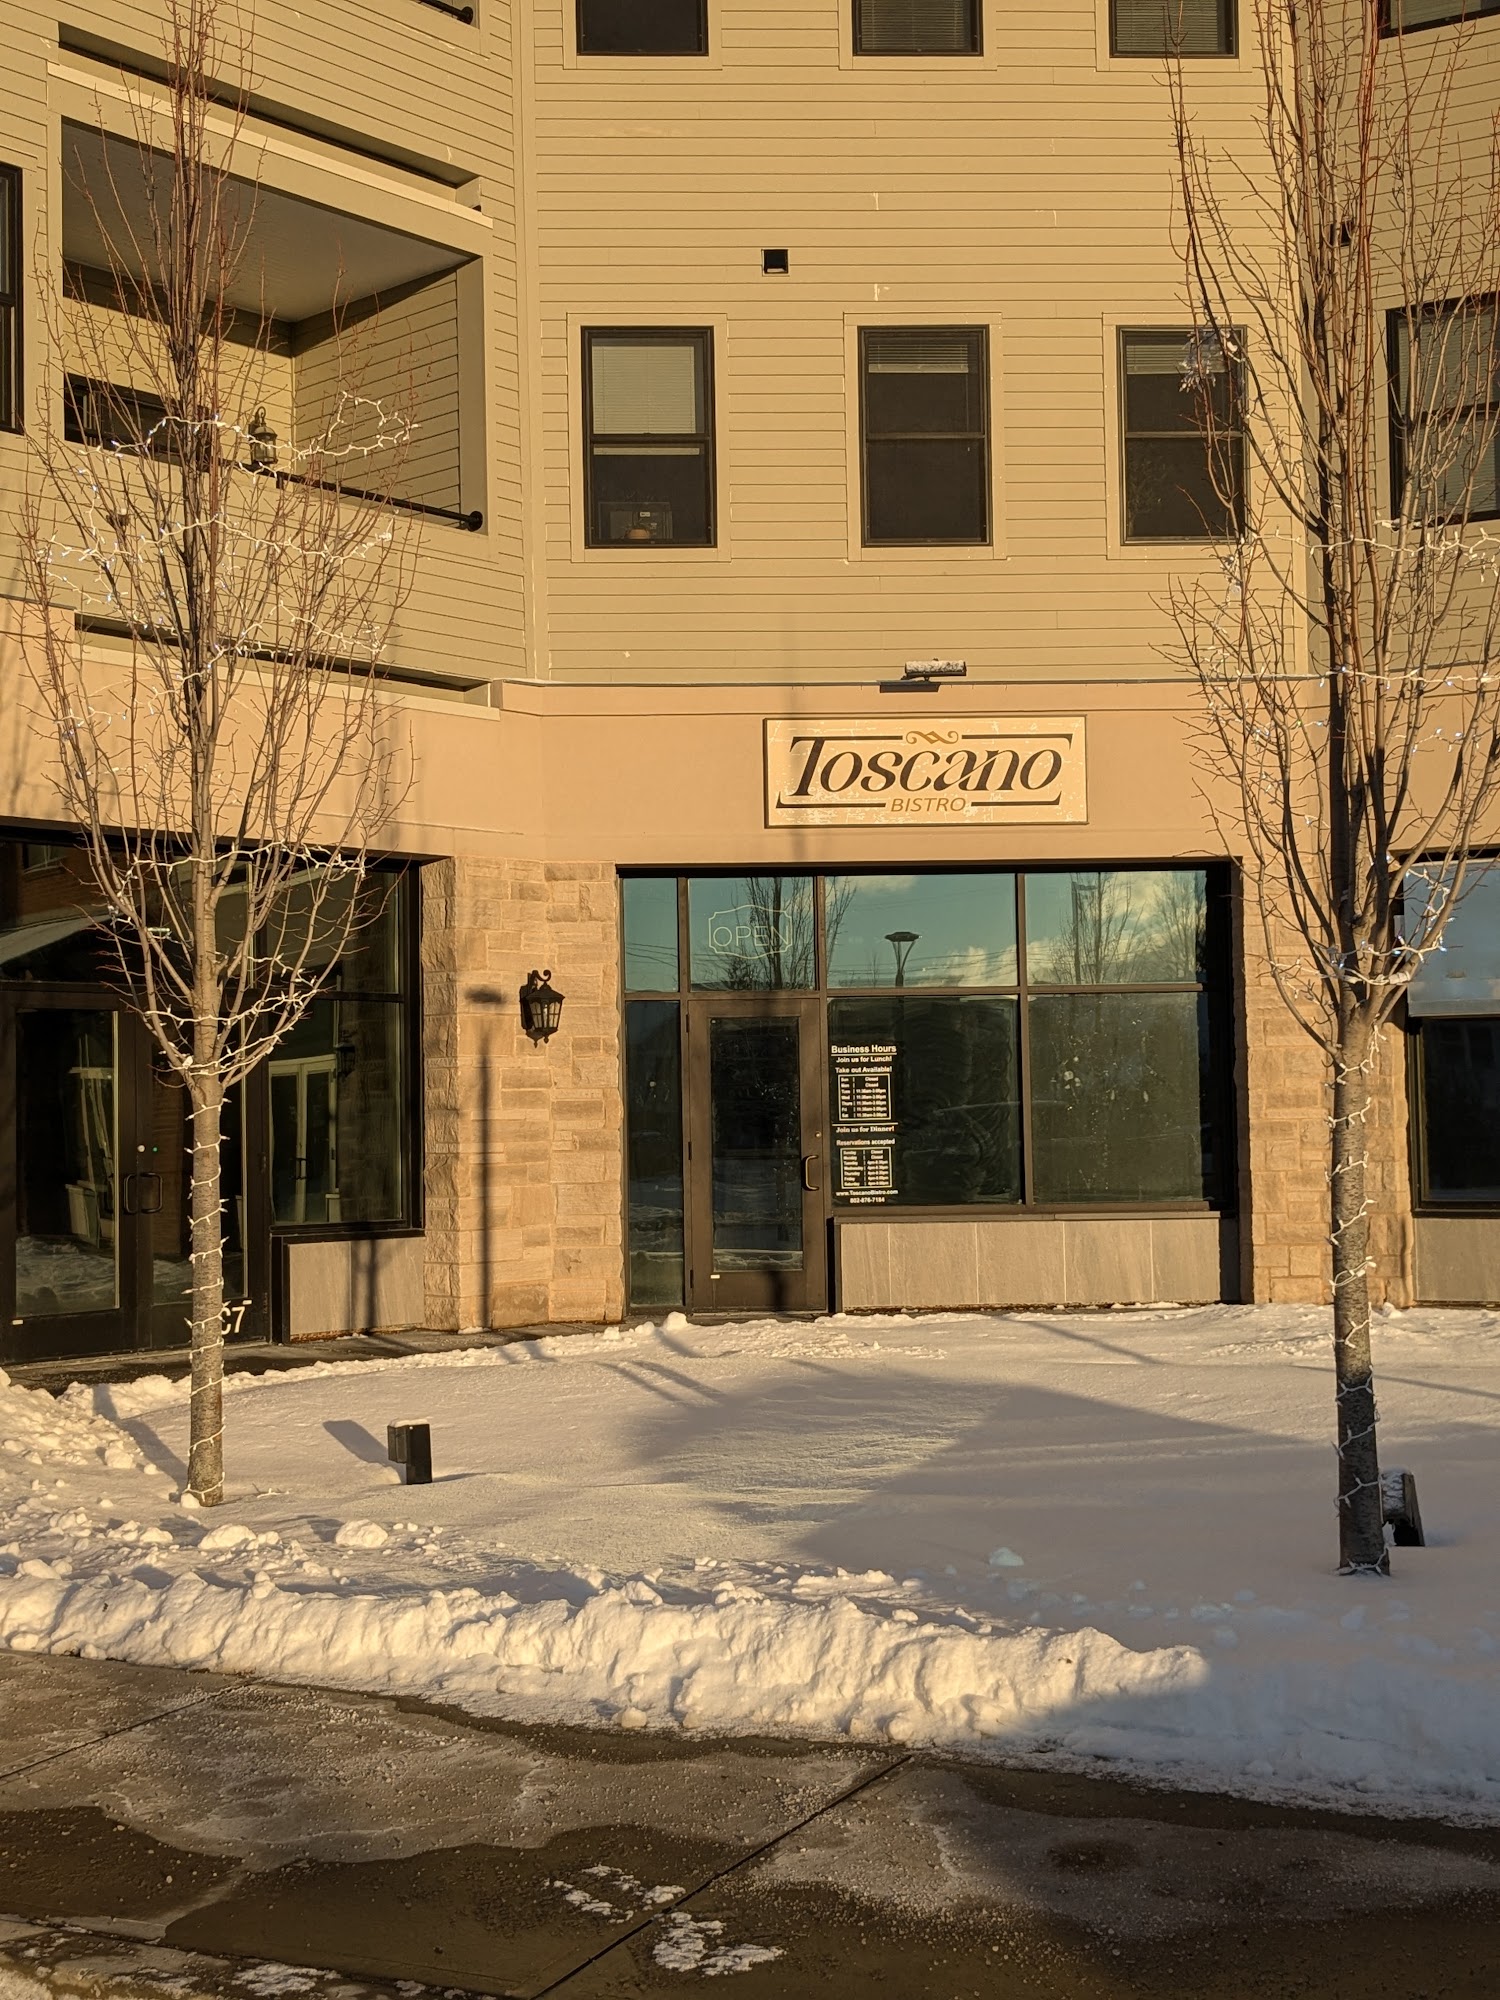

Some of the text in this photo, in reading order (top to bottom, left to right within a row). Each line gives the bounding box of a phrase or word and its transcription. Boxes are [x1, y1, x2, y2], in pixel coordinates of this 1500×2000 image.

[789, 735, 1063, 797] Toscano
[891, 797, 967, 812] BISTRO
[713, 925, 789, 947] OPEN
[831, 1044, 897, 1053] Business Hours
